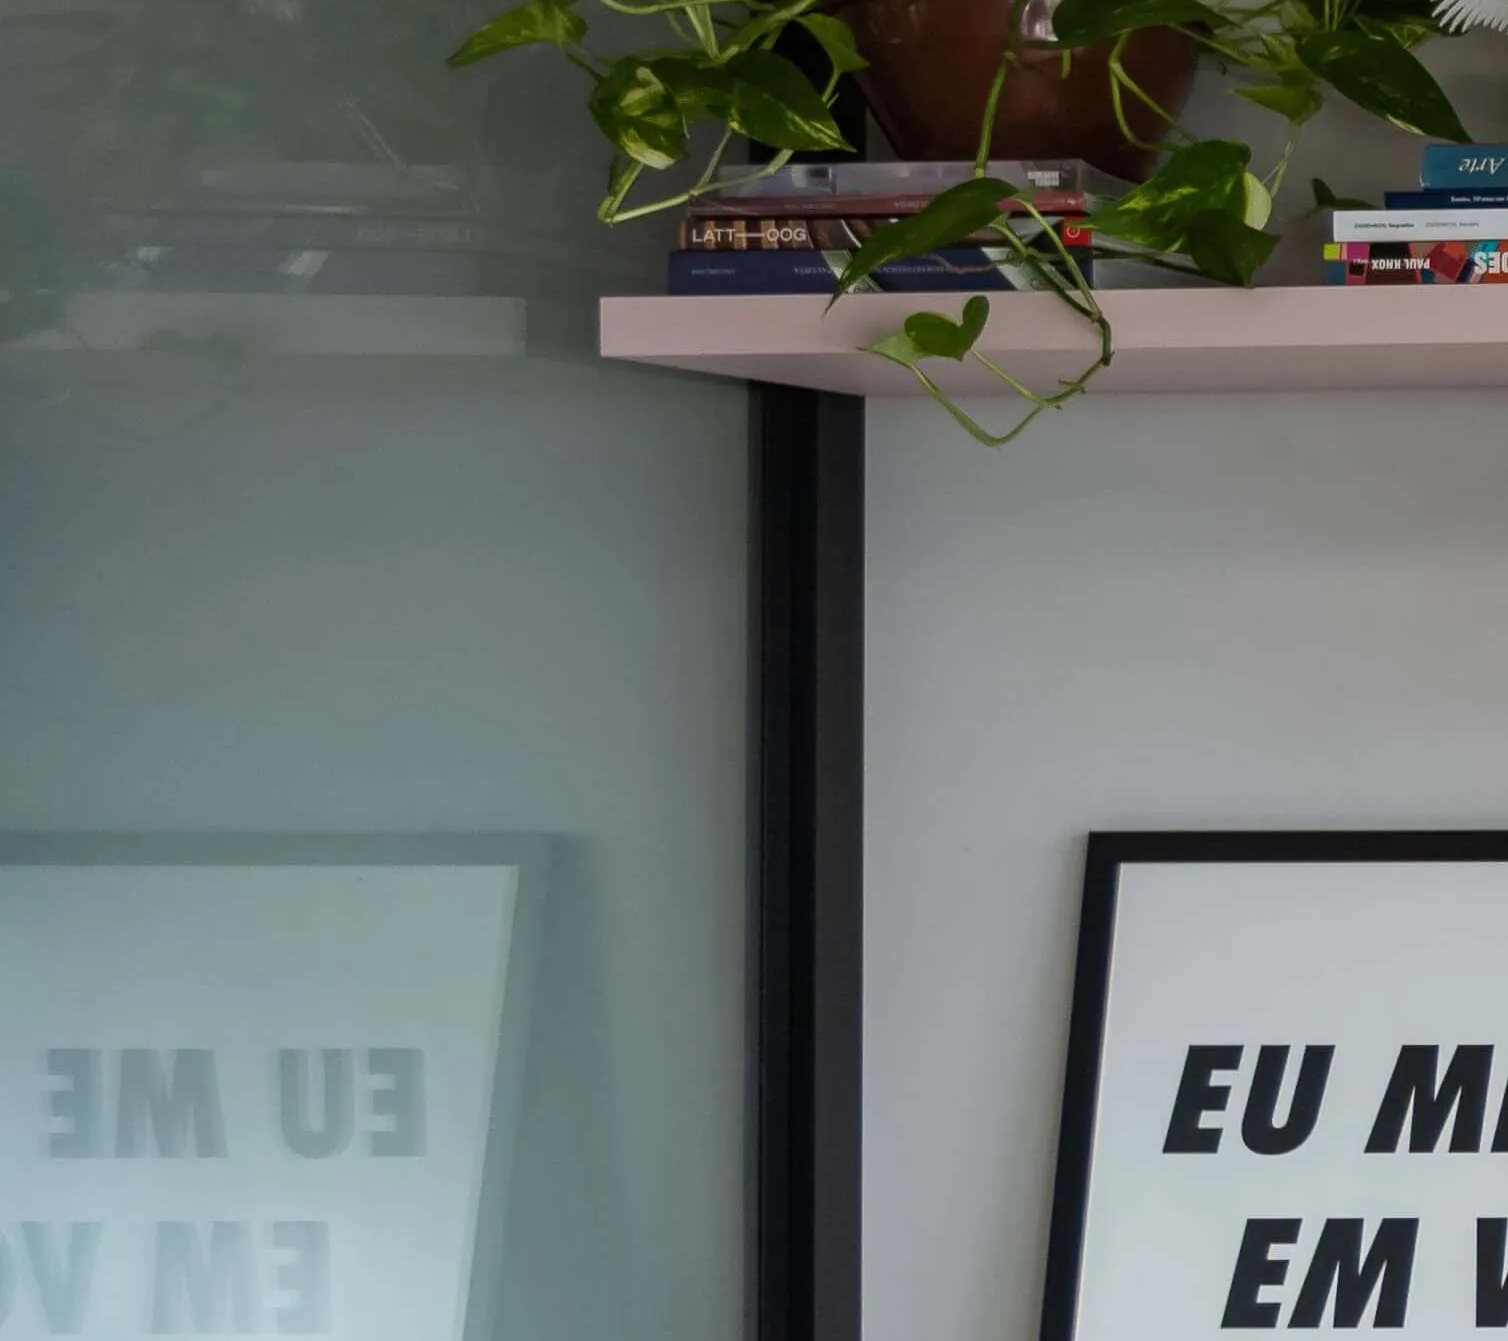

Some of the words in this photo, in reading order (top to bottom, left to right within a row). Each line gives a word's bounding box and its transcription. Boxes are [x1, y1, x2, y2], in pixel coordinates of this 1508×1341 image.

[1458, 157, 1506, 175] Arte
[1371, 259, 1402, 271] KNOX
[1404, 258, 1431, 271] PAUL
[1161, 1043, 1337, 1156] EU
[1219, 1217, 1420, 1329] EM
